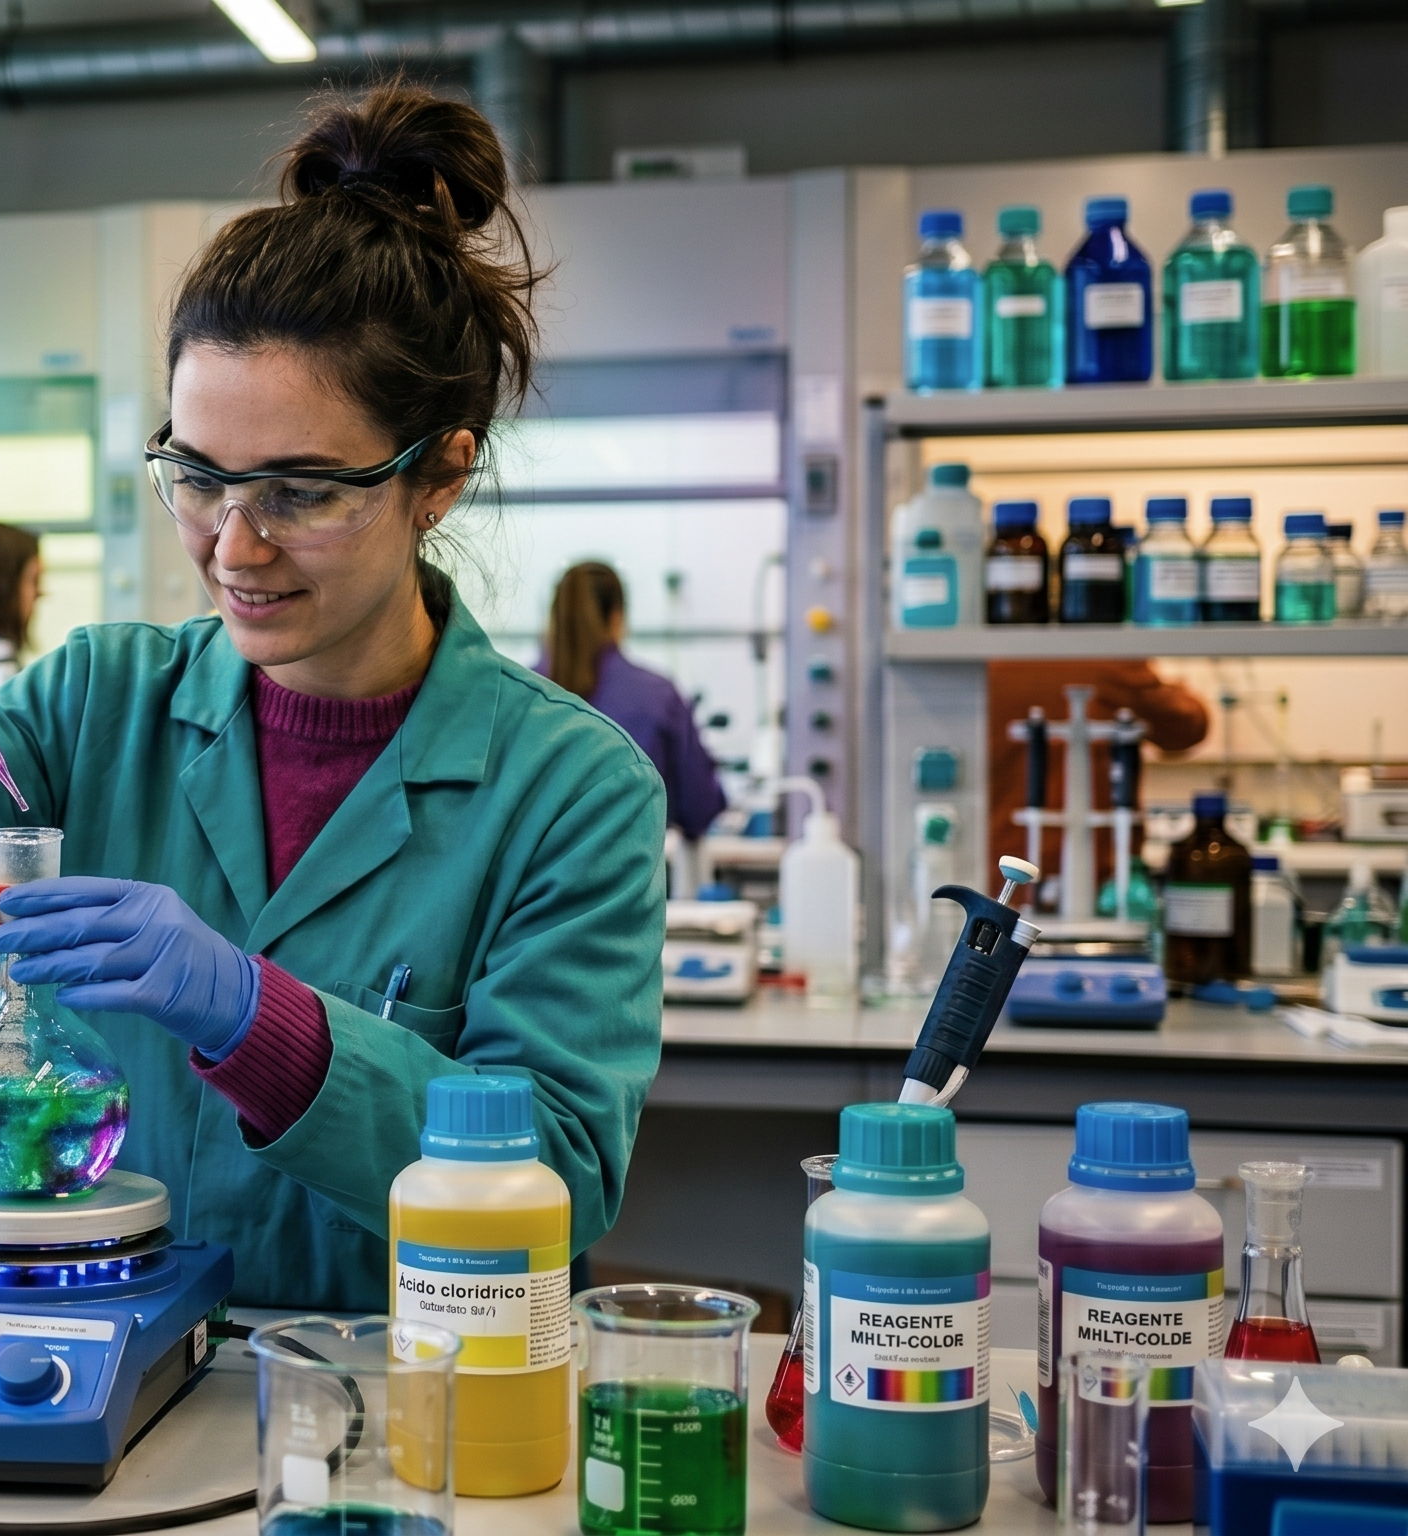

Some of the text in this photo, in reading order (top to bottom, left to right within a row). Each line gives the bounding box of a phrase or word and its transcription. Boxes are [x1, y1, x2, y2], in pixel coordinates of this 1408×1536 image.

[399, 1272, 435, 1295] Ácido
[859, 1312, 953, 1329] REAGENTE
[1087, 1308, 1183, 1326] REAGENTE
